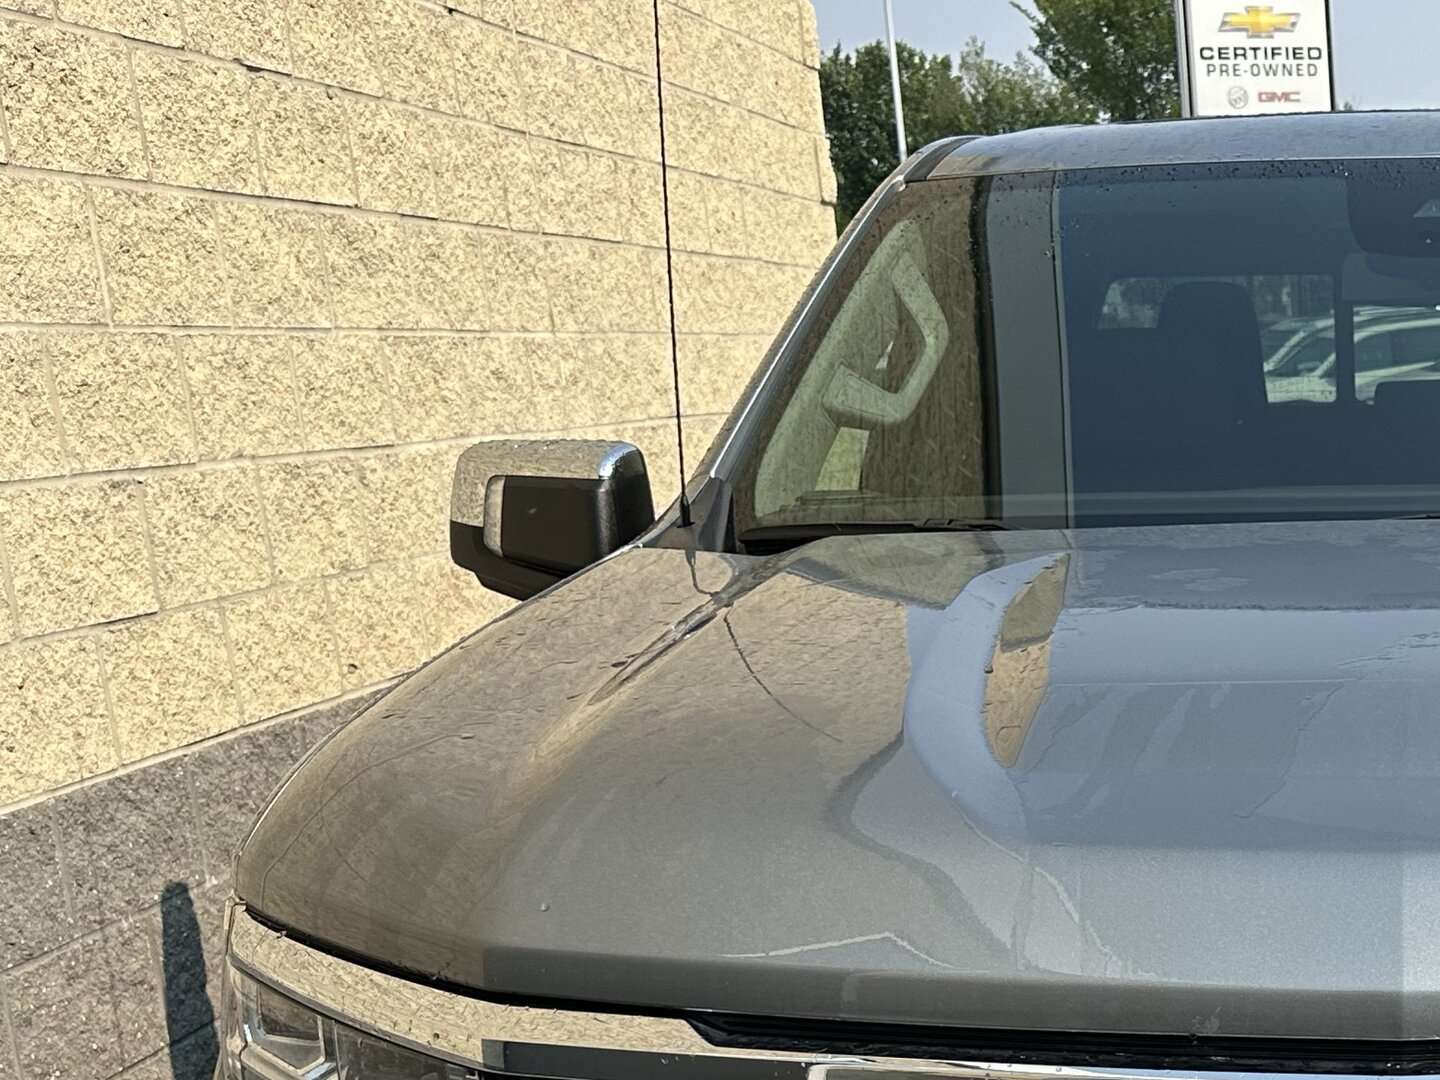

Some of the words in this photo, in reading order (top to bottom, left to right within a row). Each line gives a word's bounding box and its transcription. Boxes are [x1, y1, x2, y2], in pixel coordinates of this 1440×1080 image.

[1199, 46, 1323, 61] CERTIFIED
[1206, 63, 1319, 78] PRE-OWNED
[1257, 91, 1301, 103] GMC
